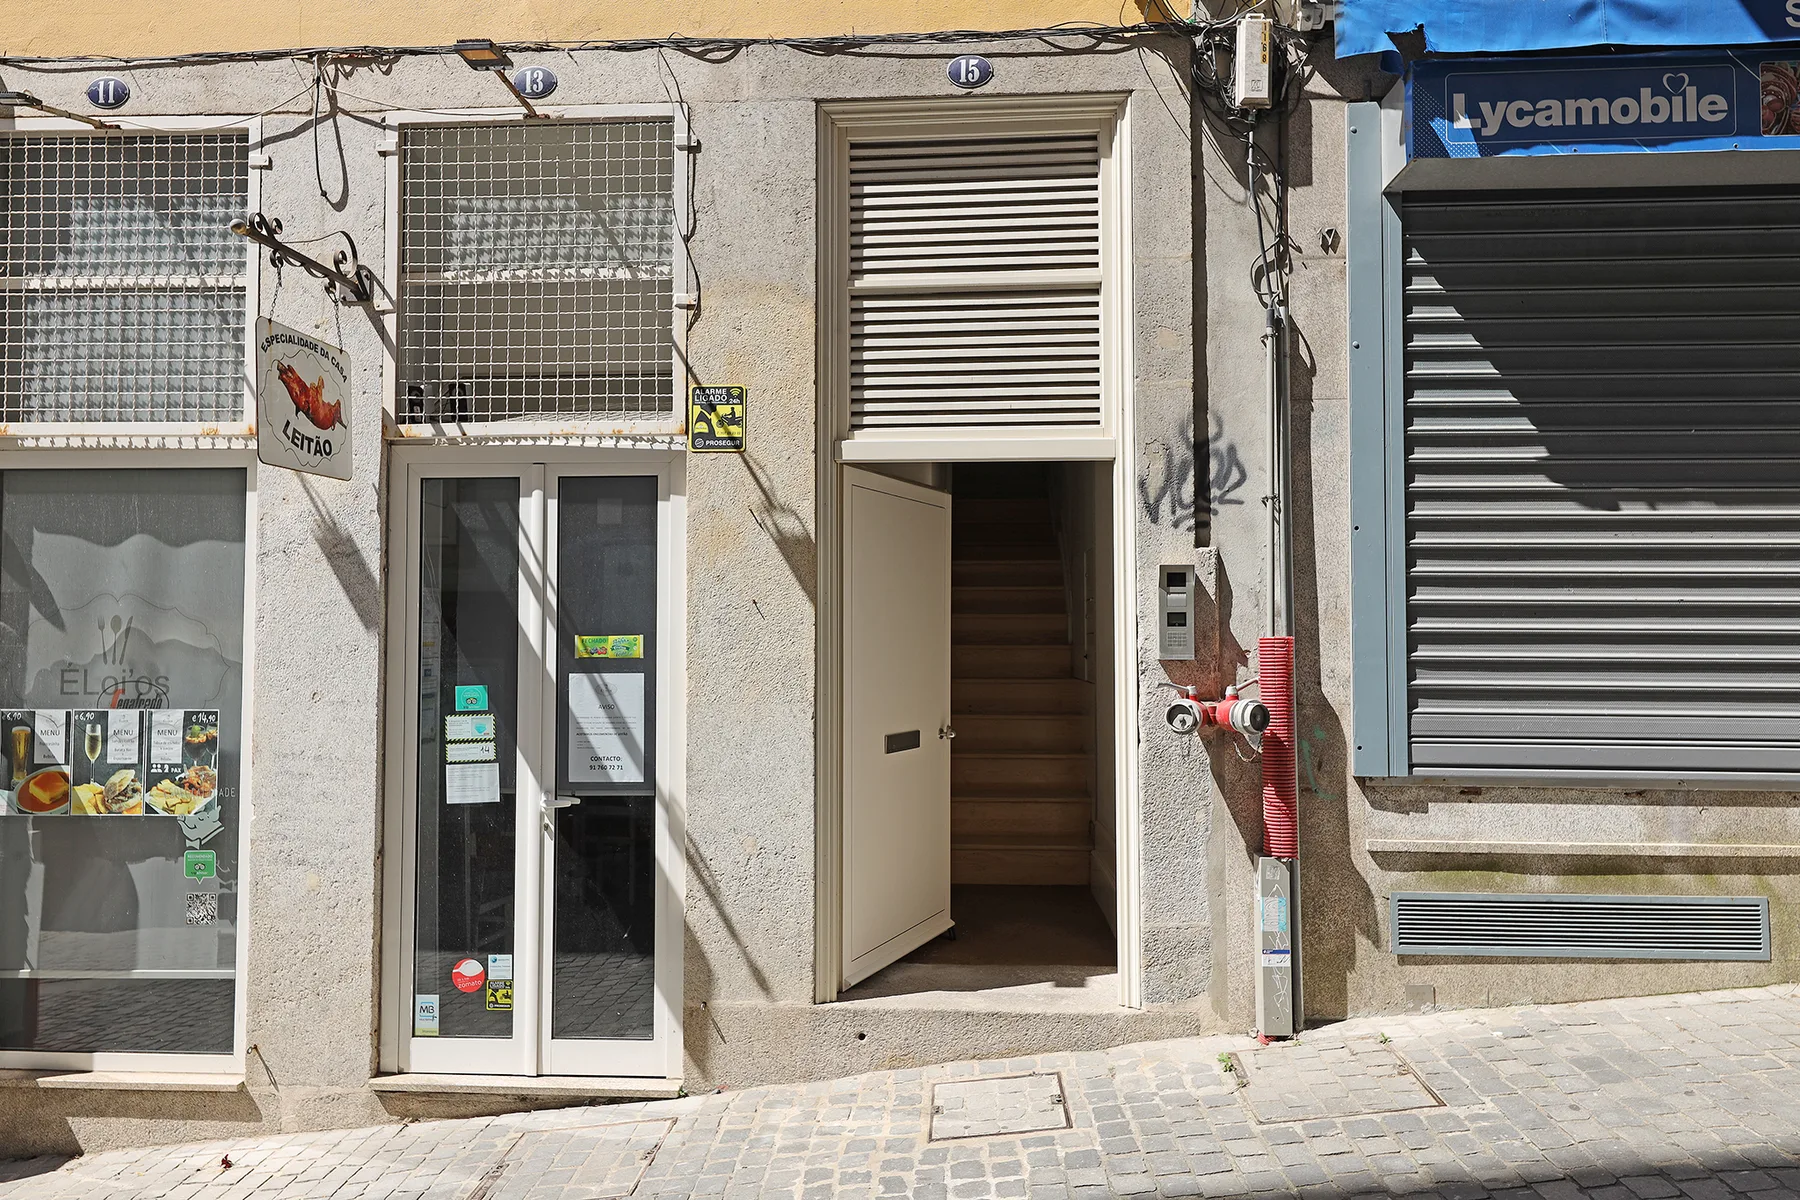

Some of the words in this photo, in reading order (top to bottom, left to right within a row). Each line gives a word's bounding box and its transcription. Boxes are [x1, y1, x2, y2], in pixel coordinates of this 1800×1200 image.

[524, 70, 544, 92] 13
[959, 59, 980, 82] 15
[97, 81, 115, 103] 11
[1452, 82, 1729, 136] Lycamobile
[261, 333, 319, 353] ESPECIALIDADE
[320, 348, 330, 361] DA
[331, 356, 348, 383] CASA
[282, 419, 333, 457] LEITÃO
[164, 764, 169, 773] 2
[458, 980, 482, 989] zomato
[420, 1005, 435, 1014] MB
